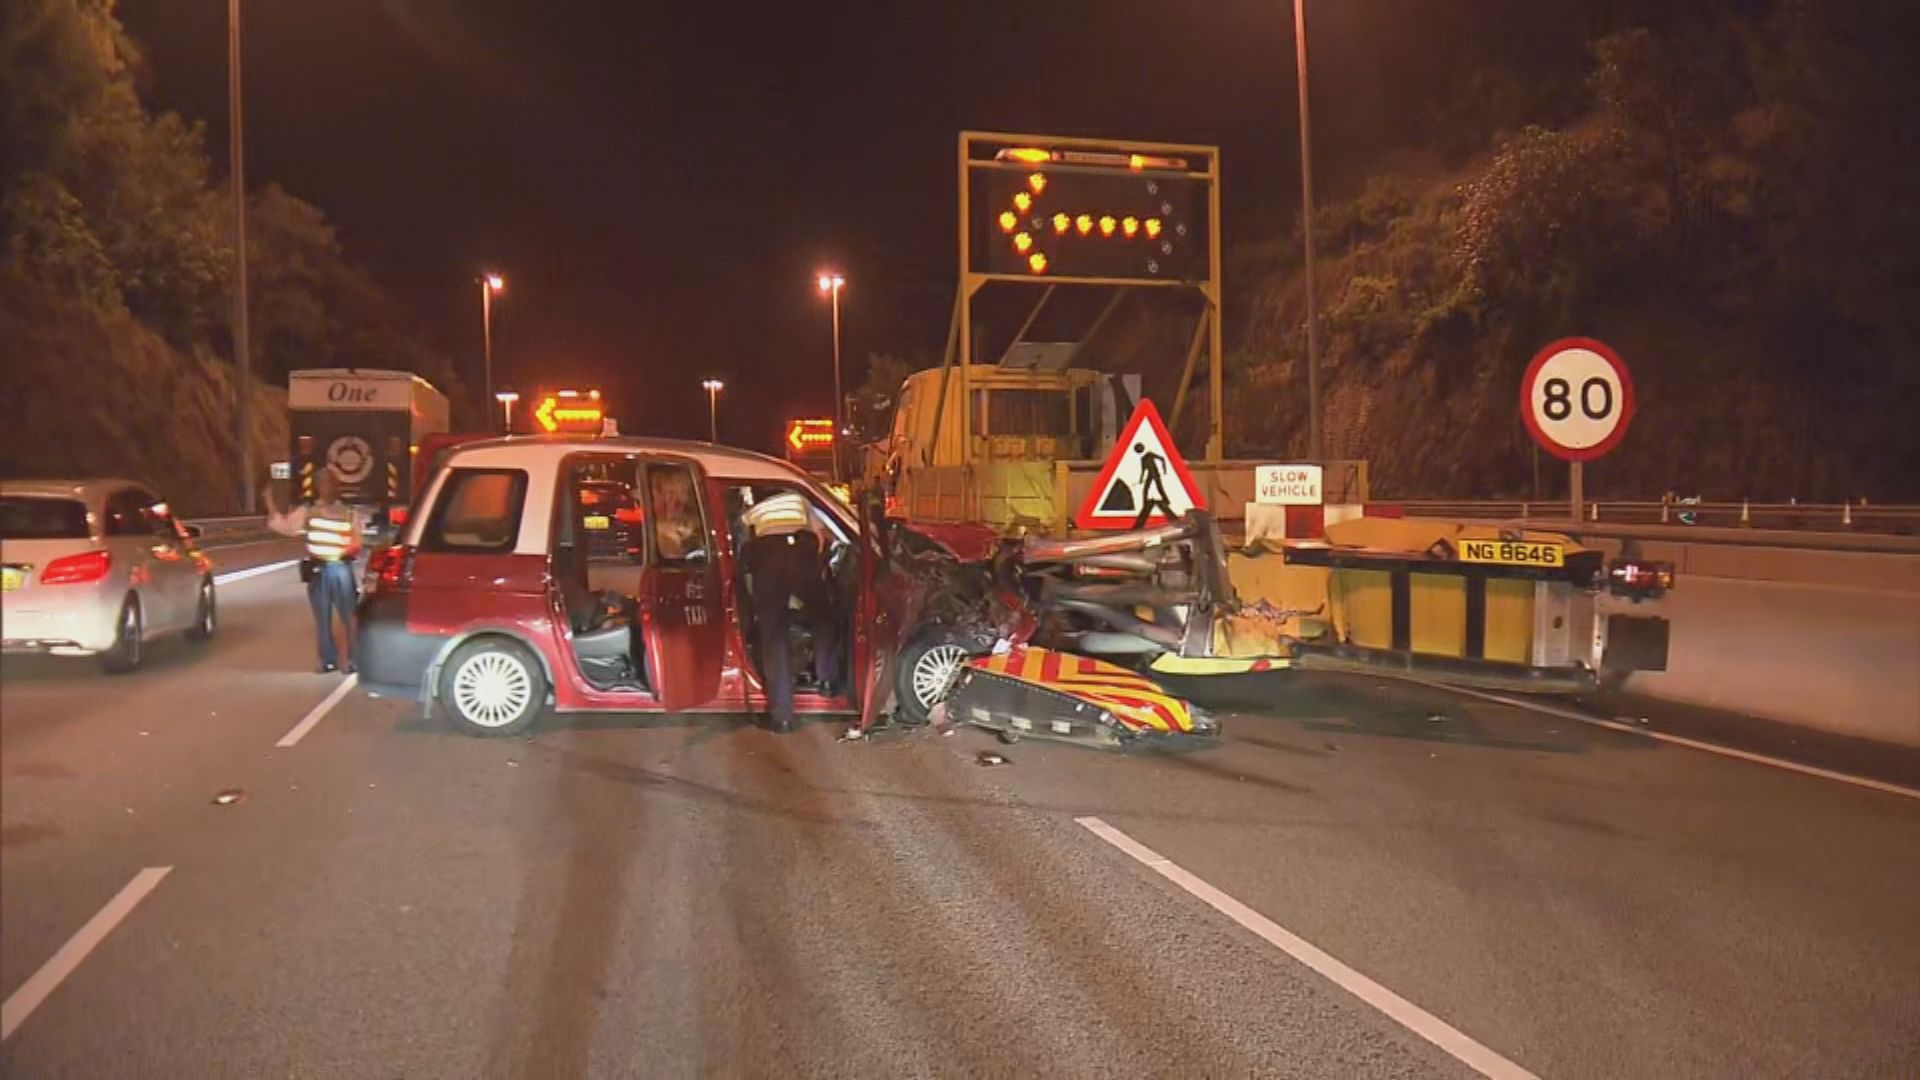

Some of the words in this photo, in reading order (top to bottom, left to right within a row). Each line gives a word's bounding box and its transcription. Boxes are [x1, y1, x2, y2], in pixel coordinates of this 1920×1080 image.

[328, 382, 377, 402] One
[1543, 377, 1613, 421] 80
[1270, 471, 1308, 483] SLOW
[1262, 484, 1316, 497] VEHICLE
[1467, 543, 1494, 560] NG
[1501, 544, 1556, 563] 8646
